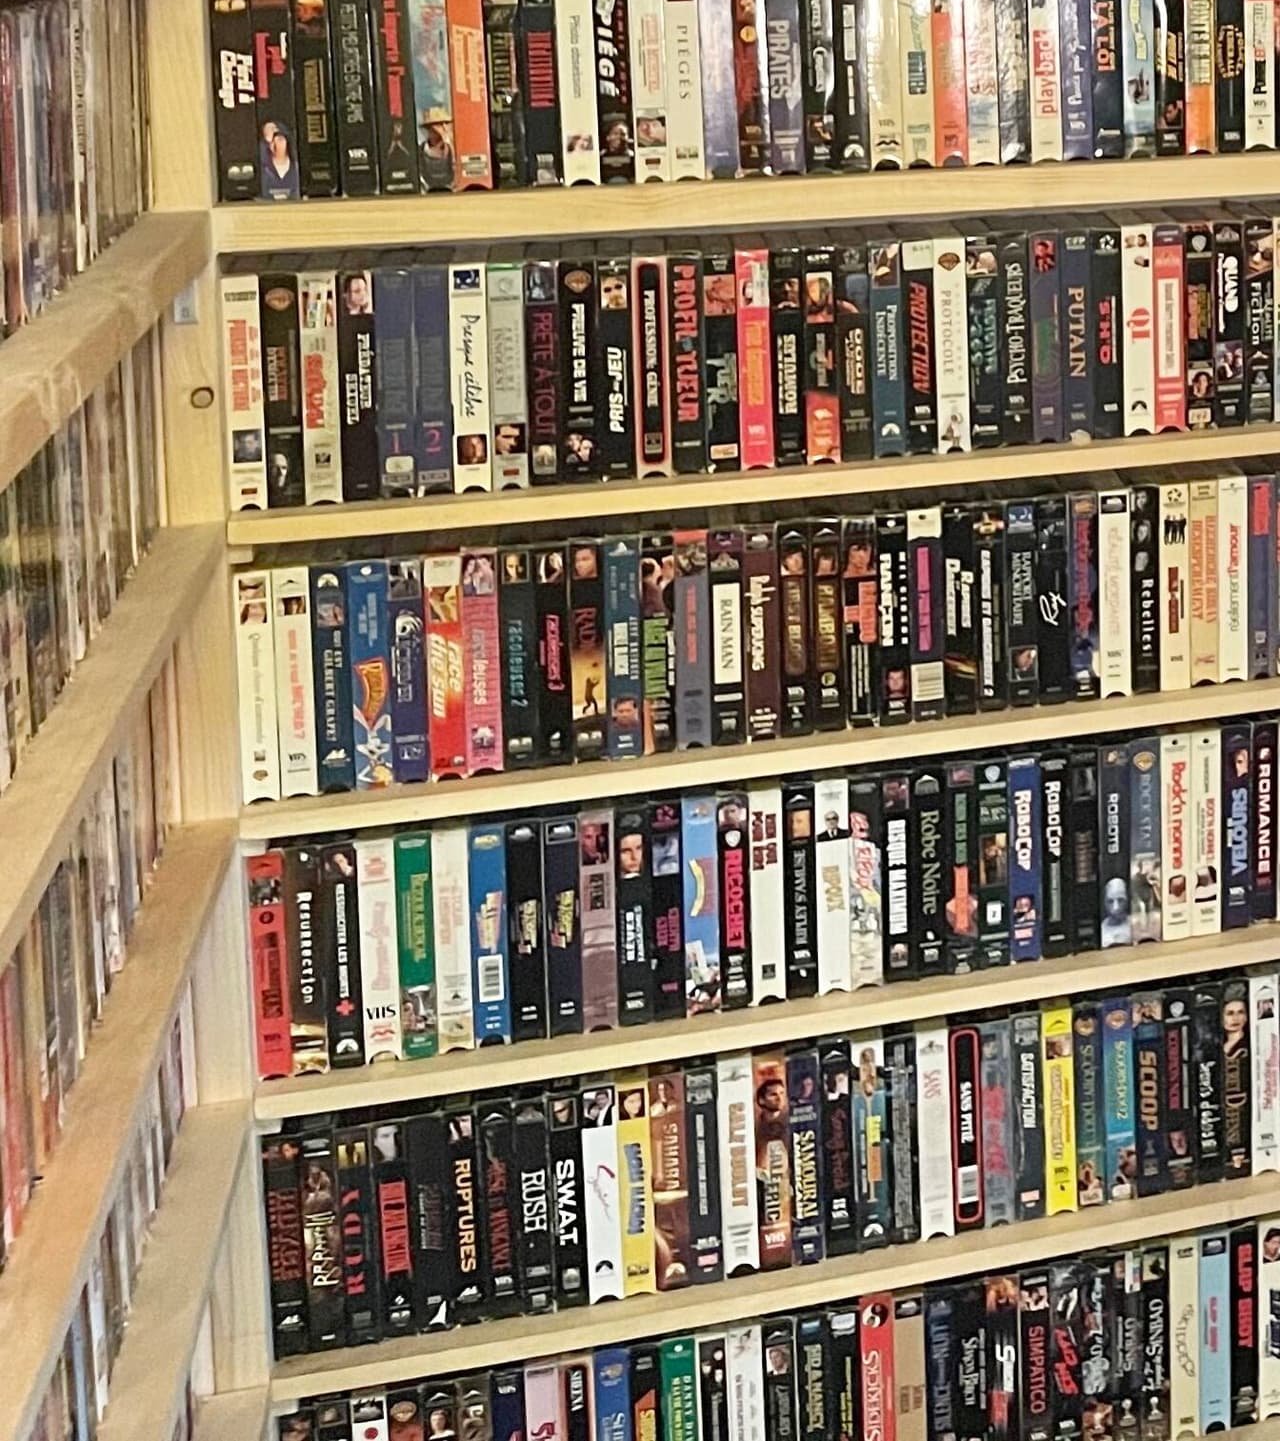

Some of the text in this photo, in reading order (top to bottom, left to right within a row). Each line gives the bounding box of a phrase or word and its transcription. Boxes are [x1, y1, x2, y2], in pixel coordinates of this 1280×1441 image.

[770, 20, 791, 100] PIRATES
[457, 314, 480, 367] Presque
[673, 264, 699, 422] PROFIL TUEUR
[886, 305, 897, 380] PROPOSITION
[910, 282, 929, 393] PROTECTION
[1007, 264, 1026, 384] PSYCHO-TRAQUEURS
[1068, 287, 1085, 378] PUTAIN
[607, 346, 624, 433] PRIS JEU
[448, 637, 462, 692] race
[720, 600, 734, 668] RAIN MAN
[430, 676, 446, 718] sun
[1106, 793, 1119, 855] ROBOTS
[1231, 788, 1248, 875] VELOURS
[1255, 764, 1270, 874] ROMANCE
[921, 810, 940, 914] Robe Noire
[367, 1004, 396, 1020] VHS
[960, 1081, 972, 1110] SANS
[1021, 1053, 1035, 1128] SATISFACTION
[1138, 1050, 1158, 1131] SCOOP
[455, 1159, 475, 1273] RUPTURES
[521, 1170, 547, 1234] RUSH
[556, 1159, 578, 1247] S.W.A.T.
[1028, 1325, 1045, 1414] SIMPATICO
